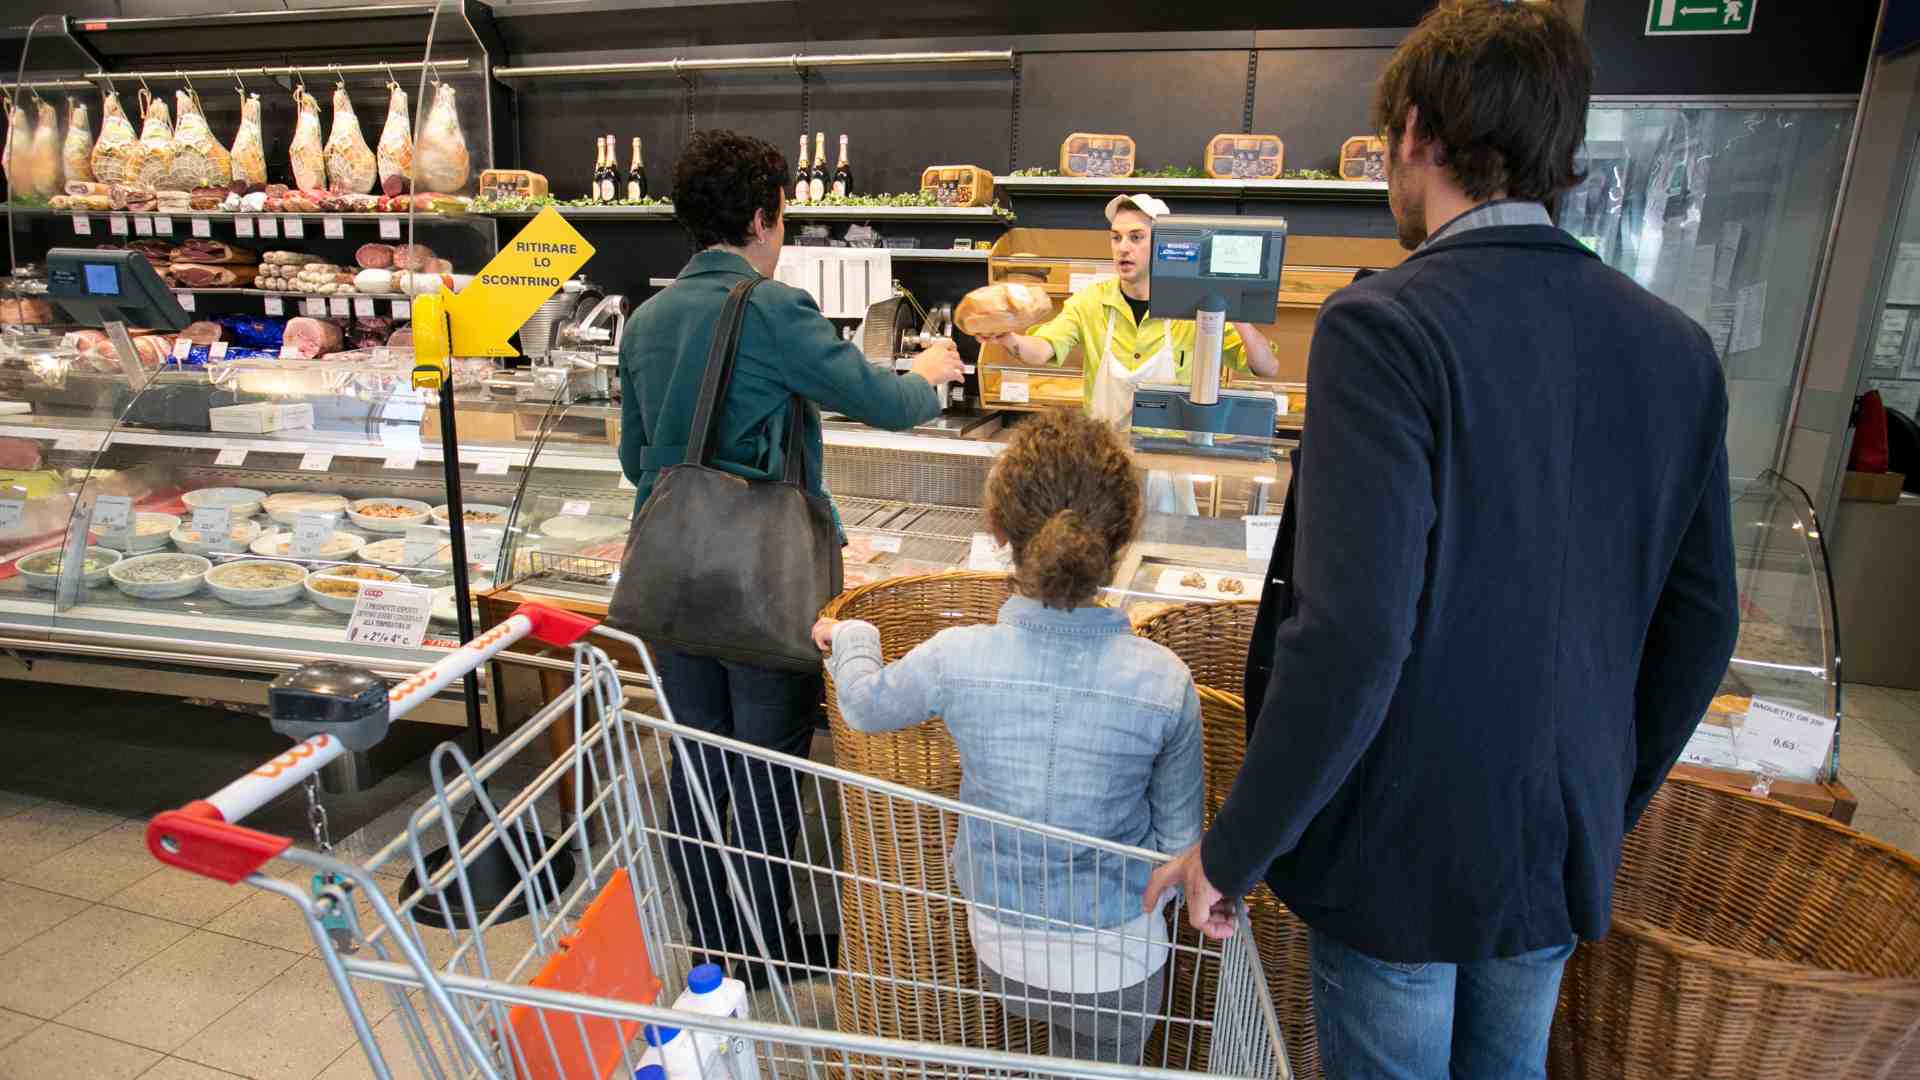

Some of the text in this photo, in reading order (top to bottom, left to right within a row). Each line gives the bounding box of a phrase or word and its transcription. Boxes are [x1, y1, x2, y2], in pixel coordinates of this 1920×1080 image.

[516, 241, 577, 254] RITIRARE
[534, 257, 551, 267] LO
[481, 274, 560, 287] SCONTRINO
[1752, 701, 1795, 720] BAGUETTE
